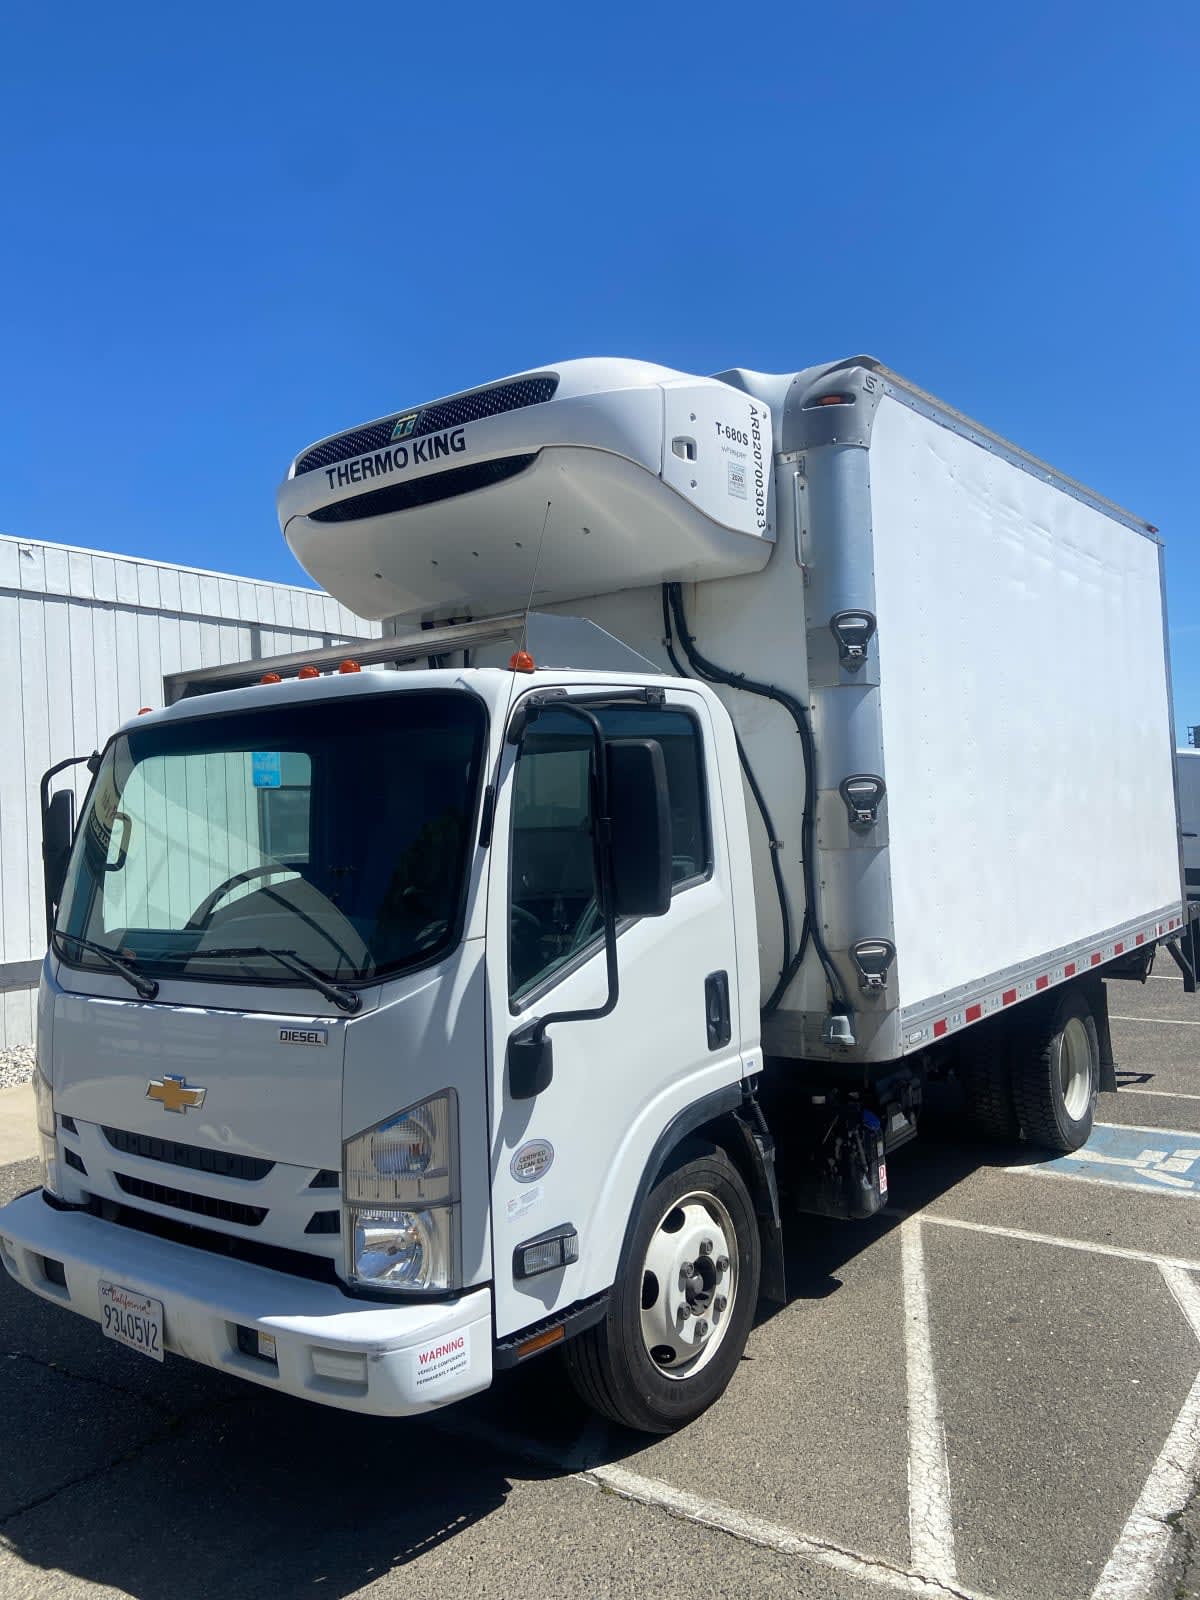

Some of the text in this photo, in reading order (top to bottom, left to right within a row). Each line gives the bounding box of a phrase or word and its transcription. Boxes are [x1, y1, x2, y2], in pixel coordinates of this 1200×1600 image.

[715, 421, 750, 447] T-680S
[325, 428, 467, 490] THERMO KING
[280, 1030, 322, 1044] DIESEL
[516, 1161, 536, 1171] CLEAN
[111, 1287, 151, 1315] California
[104, 1304, 159, 1352] 93405V2
[418, 1337, 465, 1365] WARNING
